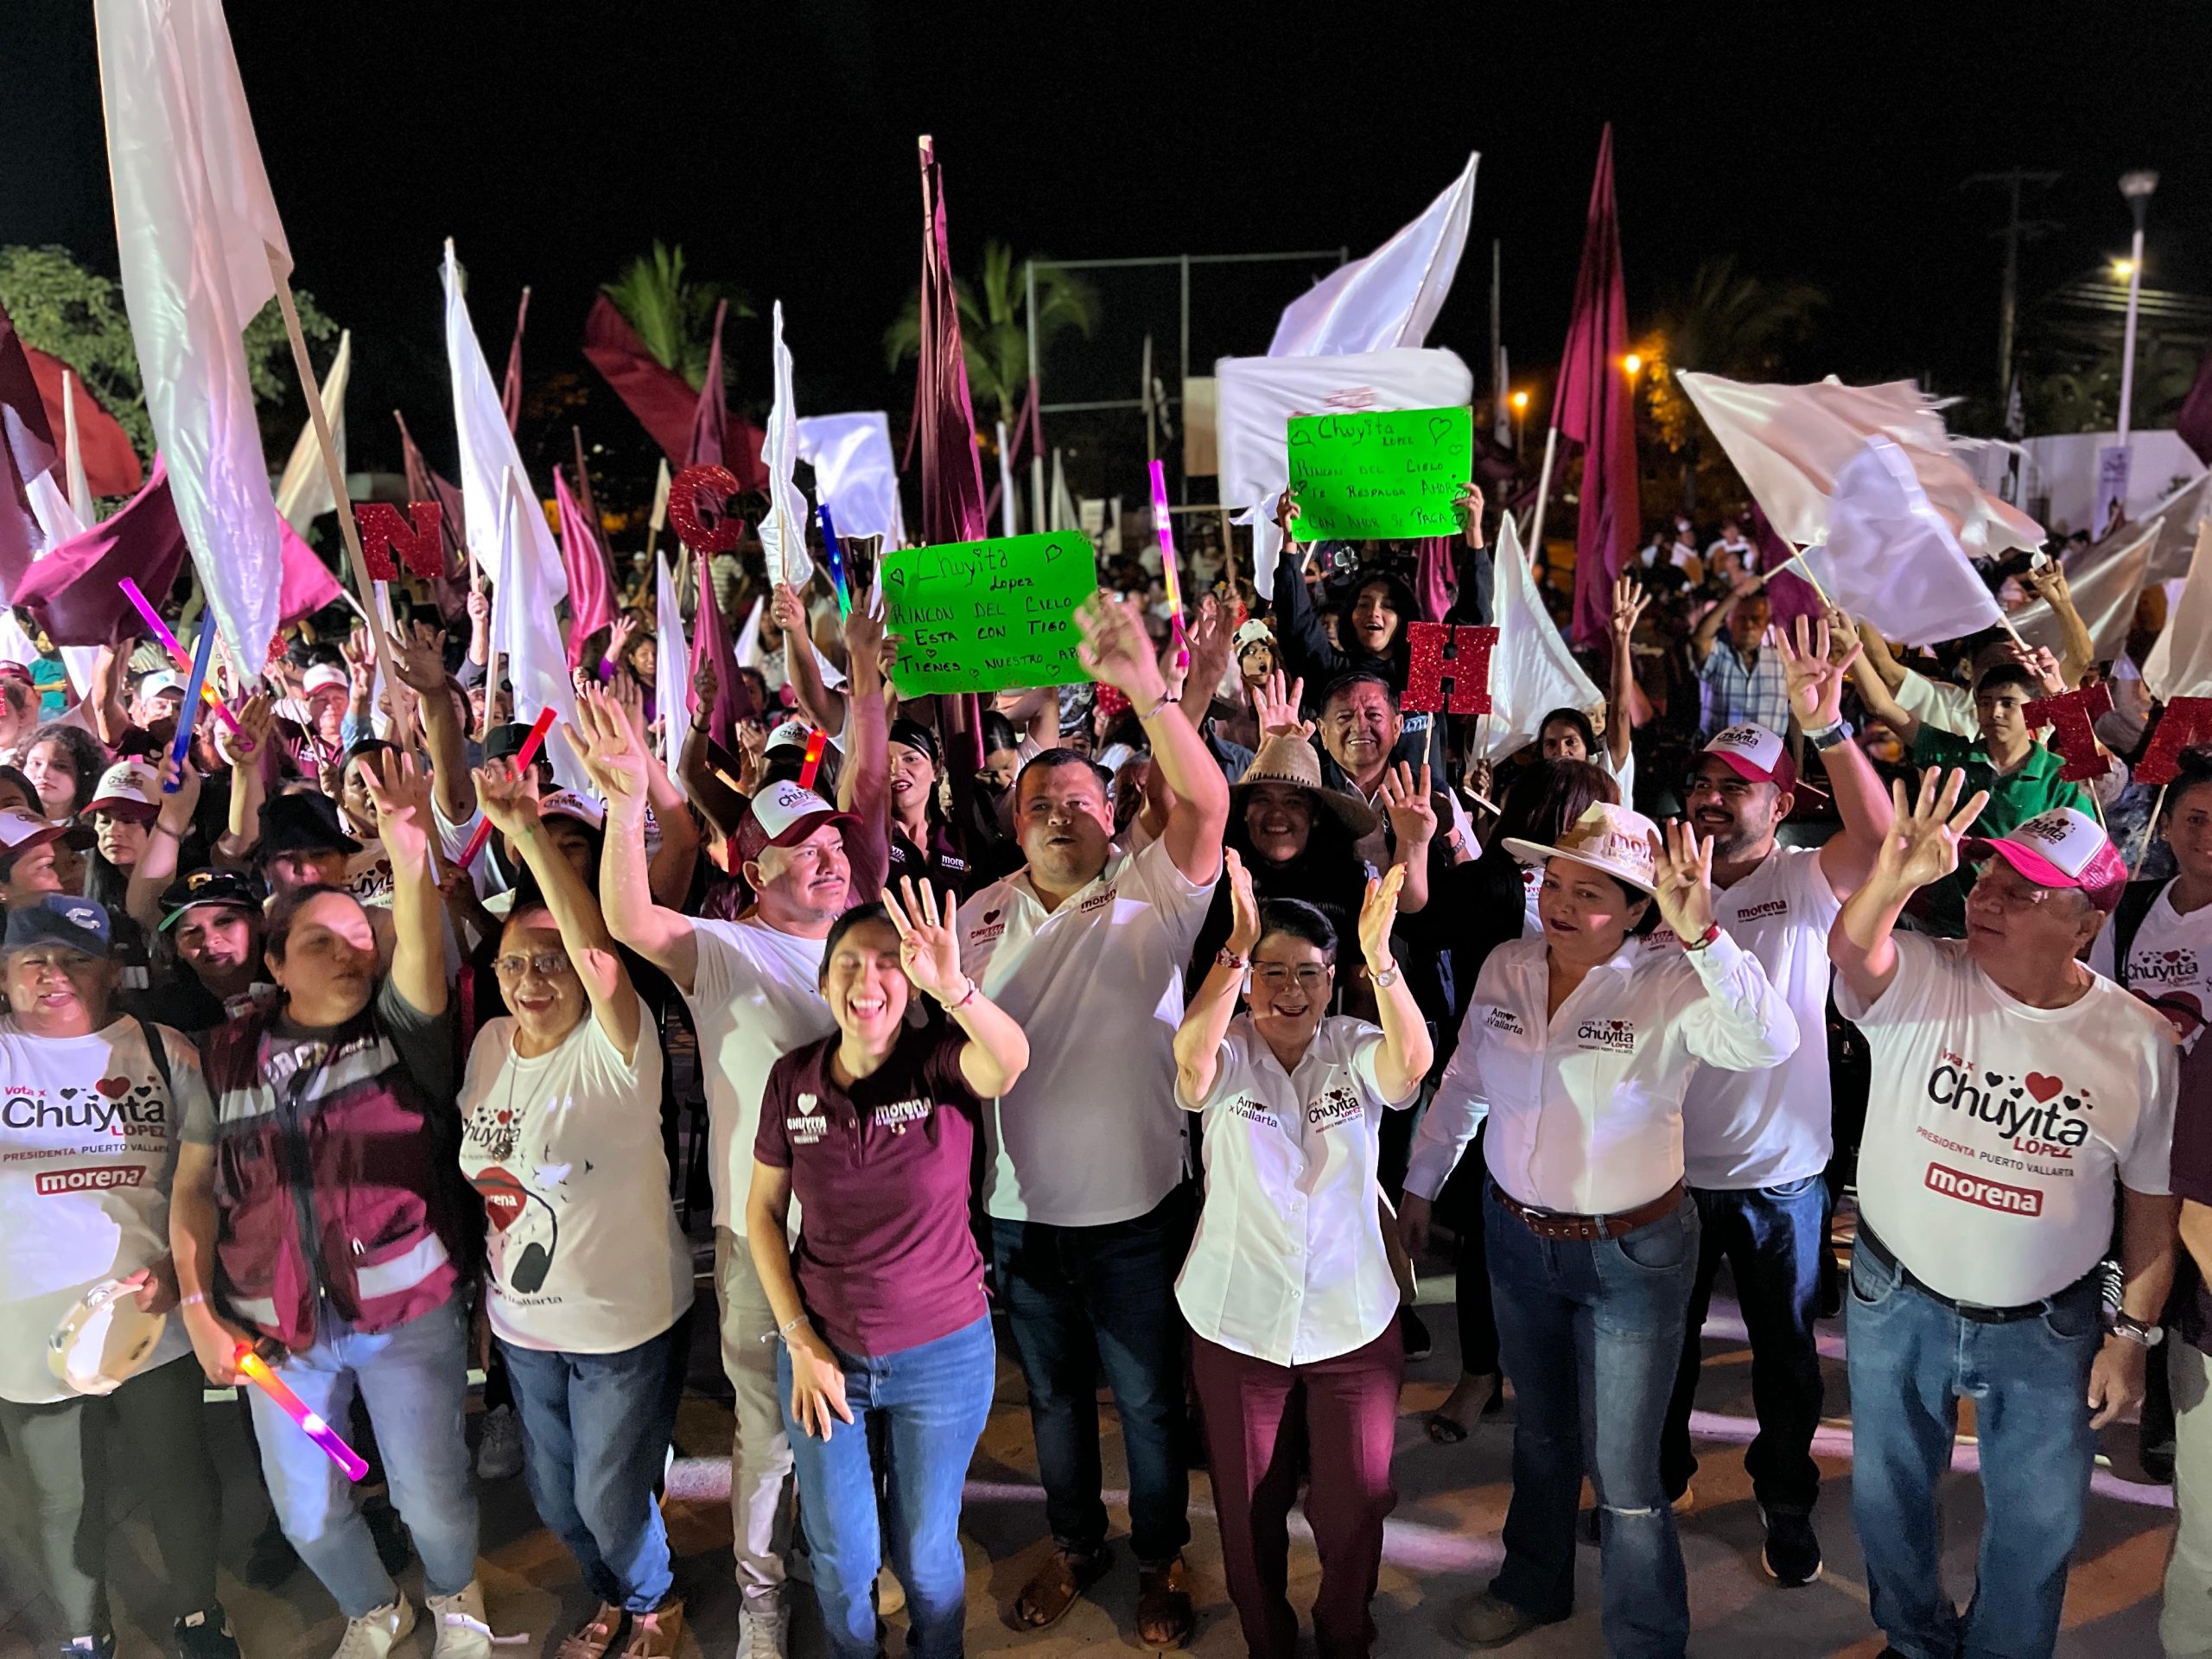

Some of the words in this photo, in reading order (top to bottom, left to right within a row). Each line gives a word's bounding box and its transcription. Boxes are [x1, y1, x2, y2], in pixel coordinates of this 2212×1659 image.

[1318, 416, 1395, 446] Chuyita
[355, 501, 444, 582] N
[917, 546, 1008, 588] Chuyita
[989, 575, 1034, 594] Lopez
[893, 602, 955, 625] RINCON
[974, 602, 1006, 619] DEL
[977, 626, 1007, 639] CON
[983, 654, 1044, 671] NUESTRO
[1400, 621, 1501, 715] H
[1080, 887, 1118, 910] moren
[1737, 899, 1788, 918] morena
[2127, 961, 2199, 982] Chuyita
[1489, 1017, 1523, 1036] Vallarta
[1577, 1026, 1634, 1045] Chuyita
[5, 1086, 34, 1096] Vota
[2, 1095, 166, 1133] Chuyita
[875, 1096, 932, 1120] morena
[1236, 1105, 1278, 1128] Vallarta
[1308, 1096, 1359, 1124] Chuyita
[1928, 1065, 2088, 1147] Chuyita
[3, 1147, 76, 1162] PRESIDENTA
[81, 1143, 127, 1154] PUERTO
[1916, 1126, 1974, 1157] PRESIDENTA
[1980, 1152, 2024, 1170] PUERTO
[2027, 1163, 2074, 1177] VALLARTA
[2012, 1136, 2073, 1159] LÓPEZ
[41, 1169, 139, 1192] morena
[1929, 1167, 2037, 1212] morena
